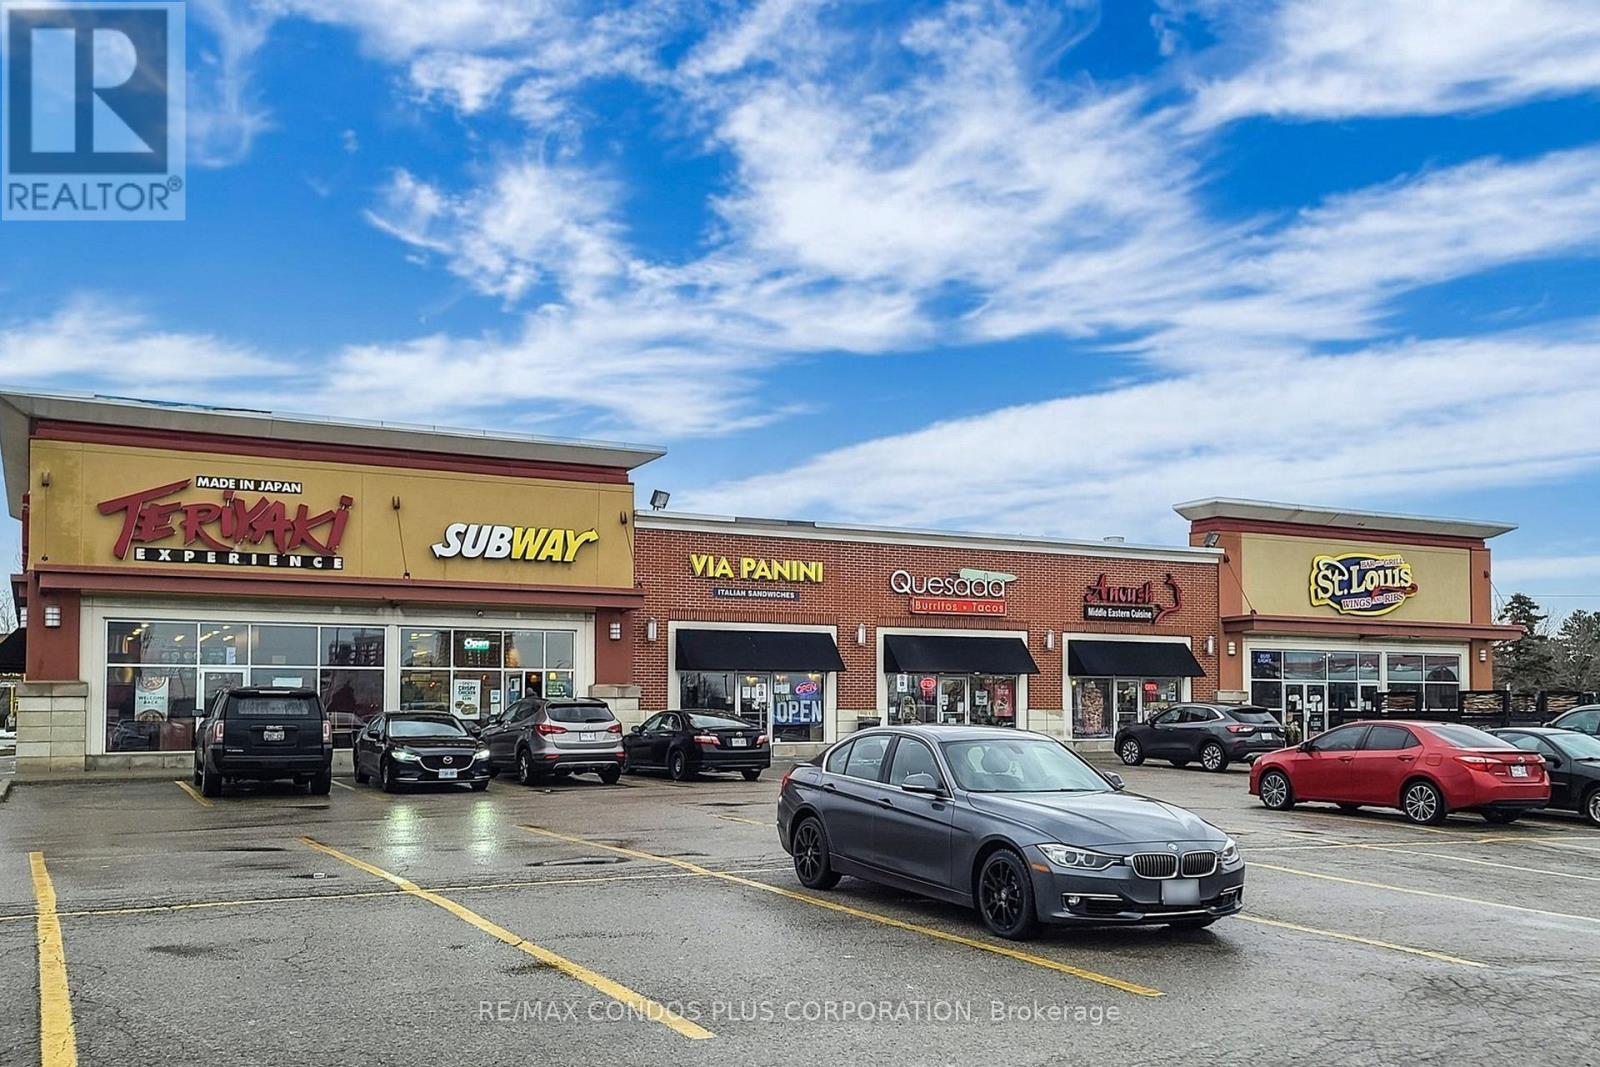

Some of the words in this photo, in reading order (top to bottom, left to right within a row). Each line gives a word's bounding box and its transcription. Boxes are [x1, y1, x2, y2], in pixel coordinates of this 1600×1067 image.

[197, 477, 236, 490] MADE
[239, 480, 255, 491] IN
[258, 481, 301, 493] JAPAN
[430, 522, 599, 562] SUBWAY
[136, 548, 342, 569] EXPERIENCE
[690, 553, 735, 578] VIA
[740, 556, 824, 583] PANINI
[890, 569, 1005, 597] Quesada
[1317, 559, 1349, 599] St.
[1349, 565, 1412, 594] Louis
[717, 588, 746, 597] ITALIAN
[747, 590, 795, 599] SANDWICHES
[1342, 599, 1371, 609] WINGS
[1384, 594, 1404, 603] RIBS
[914, 601, 958, 611] Burritos
[972, 602, 1004, 613] Tacos
[1087, 607, 1107, 617] Middle
[1108, 608, 1130, 618] Eastern
[1131, 609, 1152, 618] Cuisine
[464, 637, 490, 650] Open
[776, 700, 822, 723] OPEN
